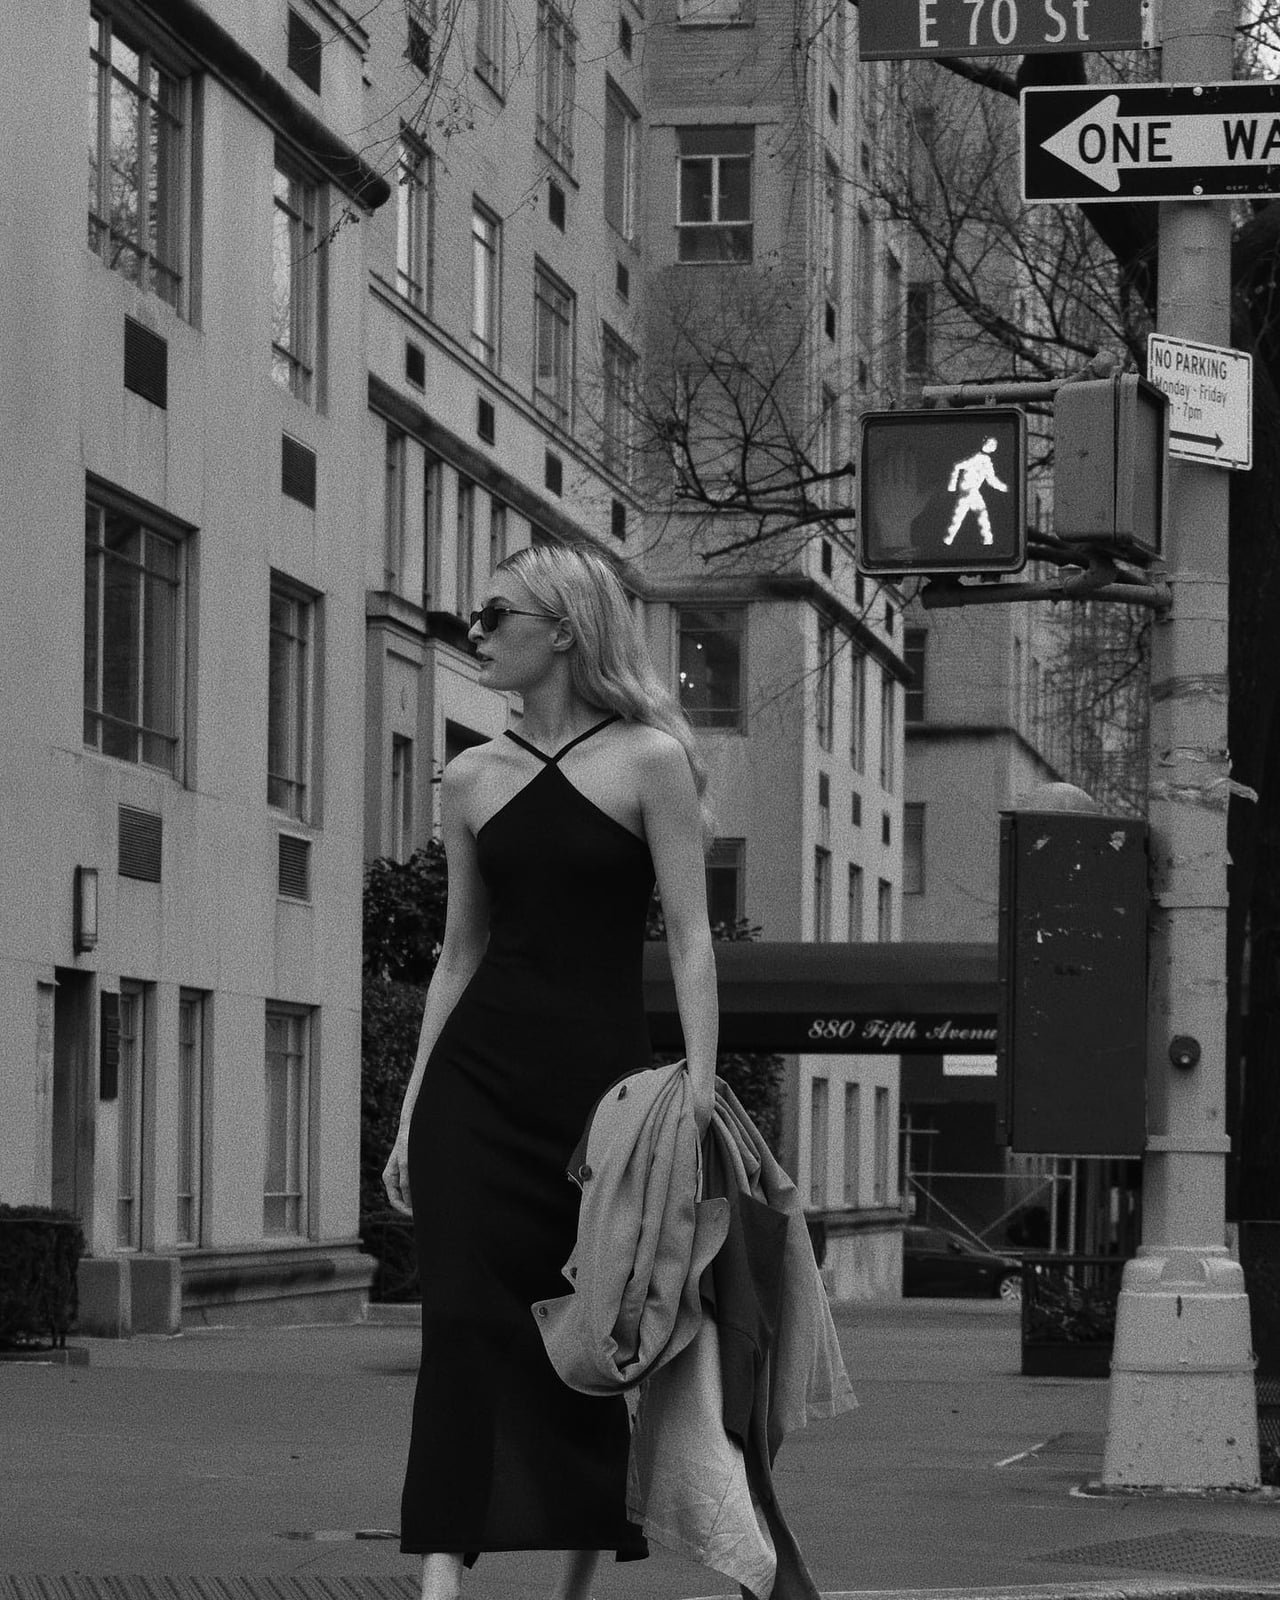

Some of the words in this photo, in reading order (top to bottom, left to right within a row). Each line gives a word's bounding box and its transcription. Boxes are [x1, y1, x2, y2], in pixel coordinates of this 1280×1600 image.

[919, 0, 939, 47] E
[963, 0, 1018, 45] 70
[1044, 0, 1090, 43] St
[1078, 122, 1173, 165] ONE
[1155, 348, 1172, 369] NO
[1176, 352, 1227, 380] PARKING
[1199, 384, 1227, 407] Friday
[808, 1019, 856, 1039] 880
[862, 1019, 917, 1046] Fifth
